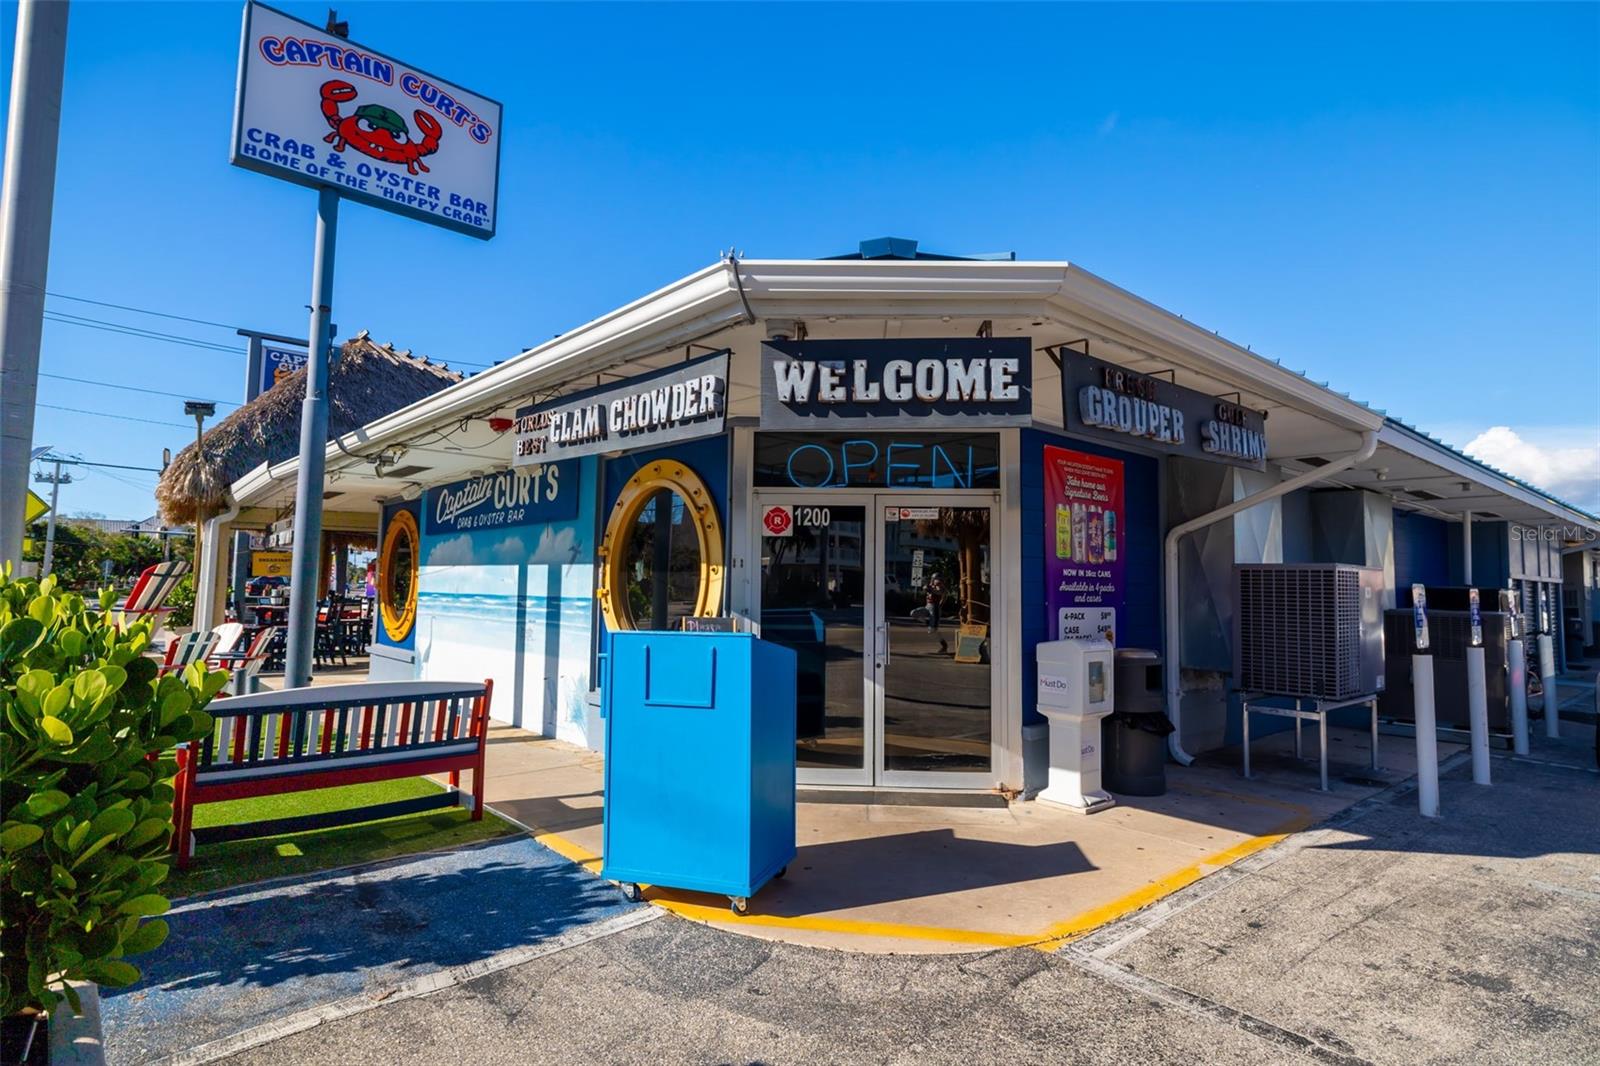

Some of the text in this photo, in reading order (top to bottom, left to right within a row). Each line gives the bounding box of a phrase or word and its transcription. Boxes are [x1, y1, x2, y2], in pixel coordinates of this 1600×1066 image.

[259, 36, 492, 144] CAPTAIN CURT'S
[244, 143, 301, 170] HOME
[305, 158, 330, 178] OF
[334, 171, 368, 191] THE
[247, 127, 488, 217] CRAB & OYSTER BAR
[772, 358, 1020, 404] WELCOME
[550, 374, 721, 444] CLAM CHOWDER
[1082, 385, 1185, 445] GROUPER
[516, 435, 548, 456] BEST
[786, 440, 976, 489] OPEN
[436, 464, 560, 524] Captain CURT'S
[457, 517, 472, 530] CRAB
[479, 511, 505, 526] OYSTER
[508, 508, 525, 523] BAR
[774, 516, 782, 525] R
[794, 507, 831, 528] 1200
[1062, 568, 1078, 577] NOW
[1078, 569, 1085, 577] IN
[1097, 570, 1112, 578] CANS
[1059, 580, 1089, 592] Available
[1064, 612, 1086, 621] 4-PACK
[1063, 626, 1080, 635] CASE
[1040, 678, 1067, 689] Must Do
